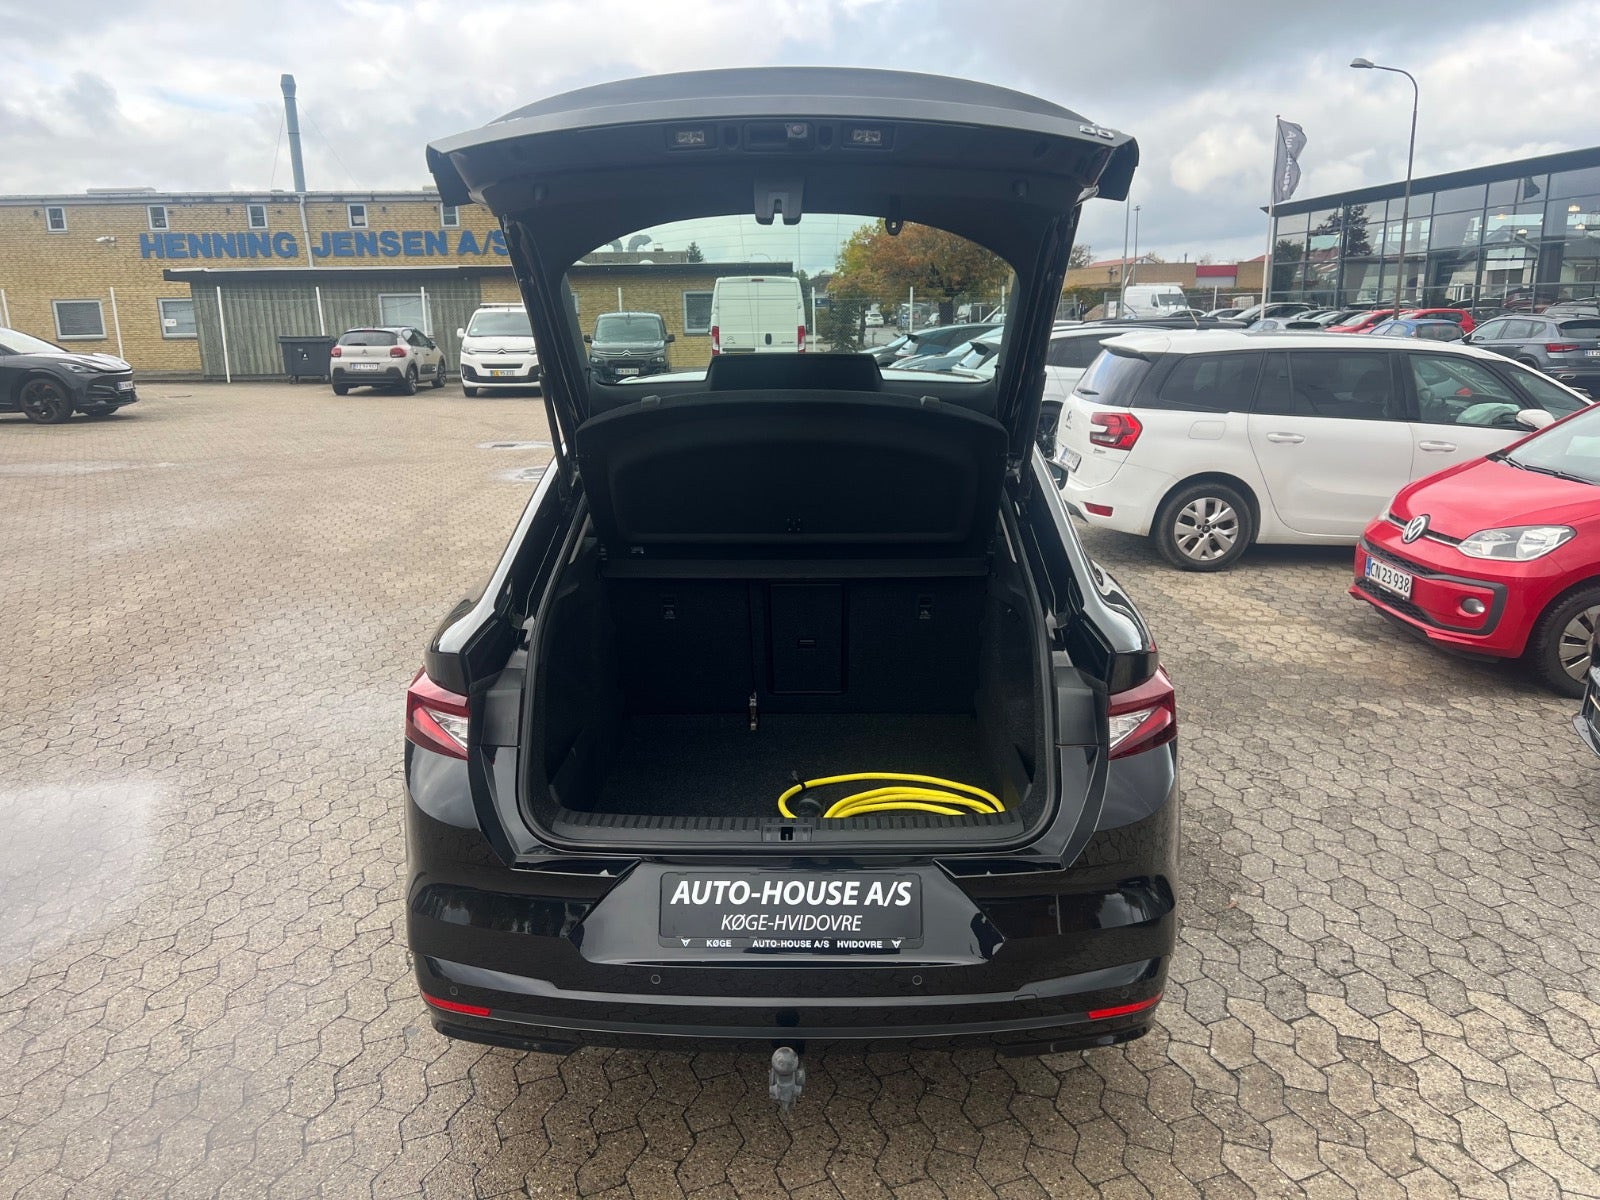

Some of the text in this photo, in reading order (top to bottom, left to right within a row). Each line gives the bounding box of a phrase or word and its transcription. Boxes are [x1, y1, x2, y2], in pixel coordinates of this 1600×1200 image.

[139, 230, 509, 259] HENNING JENSEN A/S
[1370, 562, 1410, 593] CN 23 938
[670, 880, 912, 907] AUTO-HOUSE A/S
[721, 913, 863, 931] KØGE-HVIDOVRE
[706, 939, 883, 948] KØGE AUTO-HOUSE A/S HVIDOVRE
